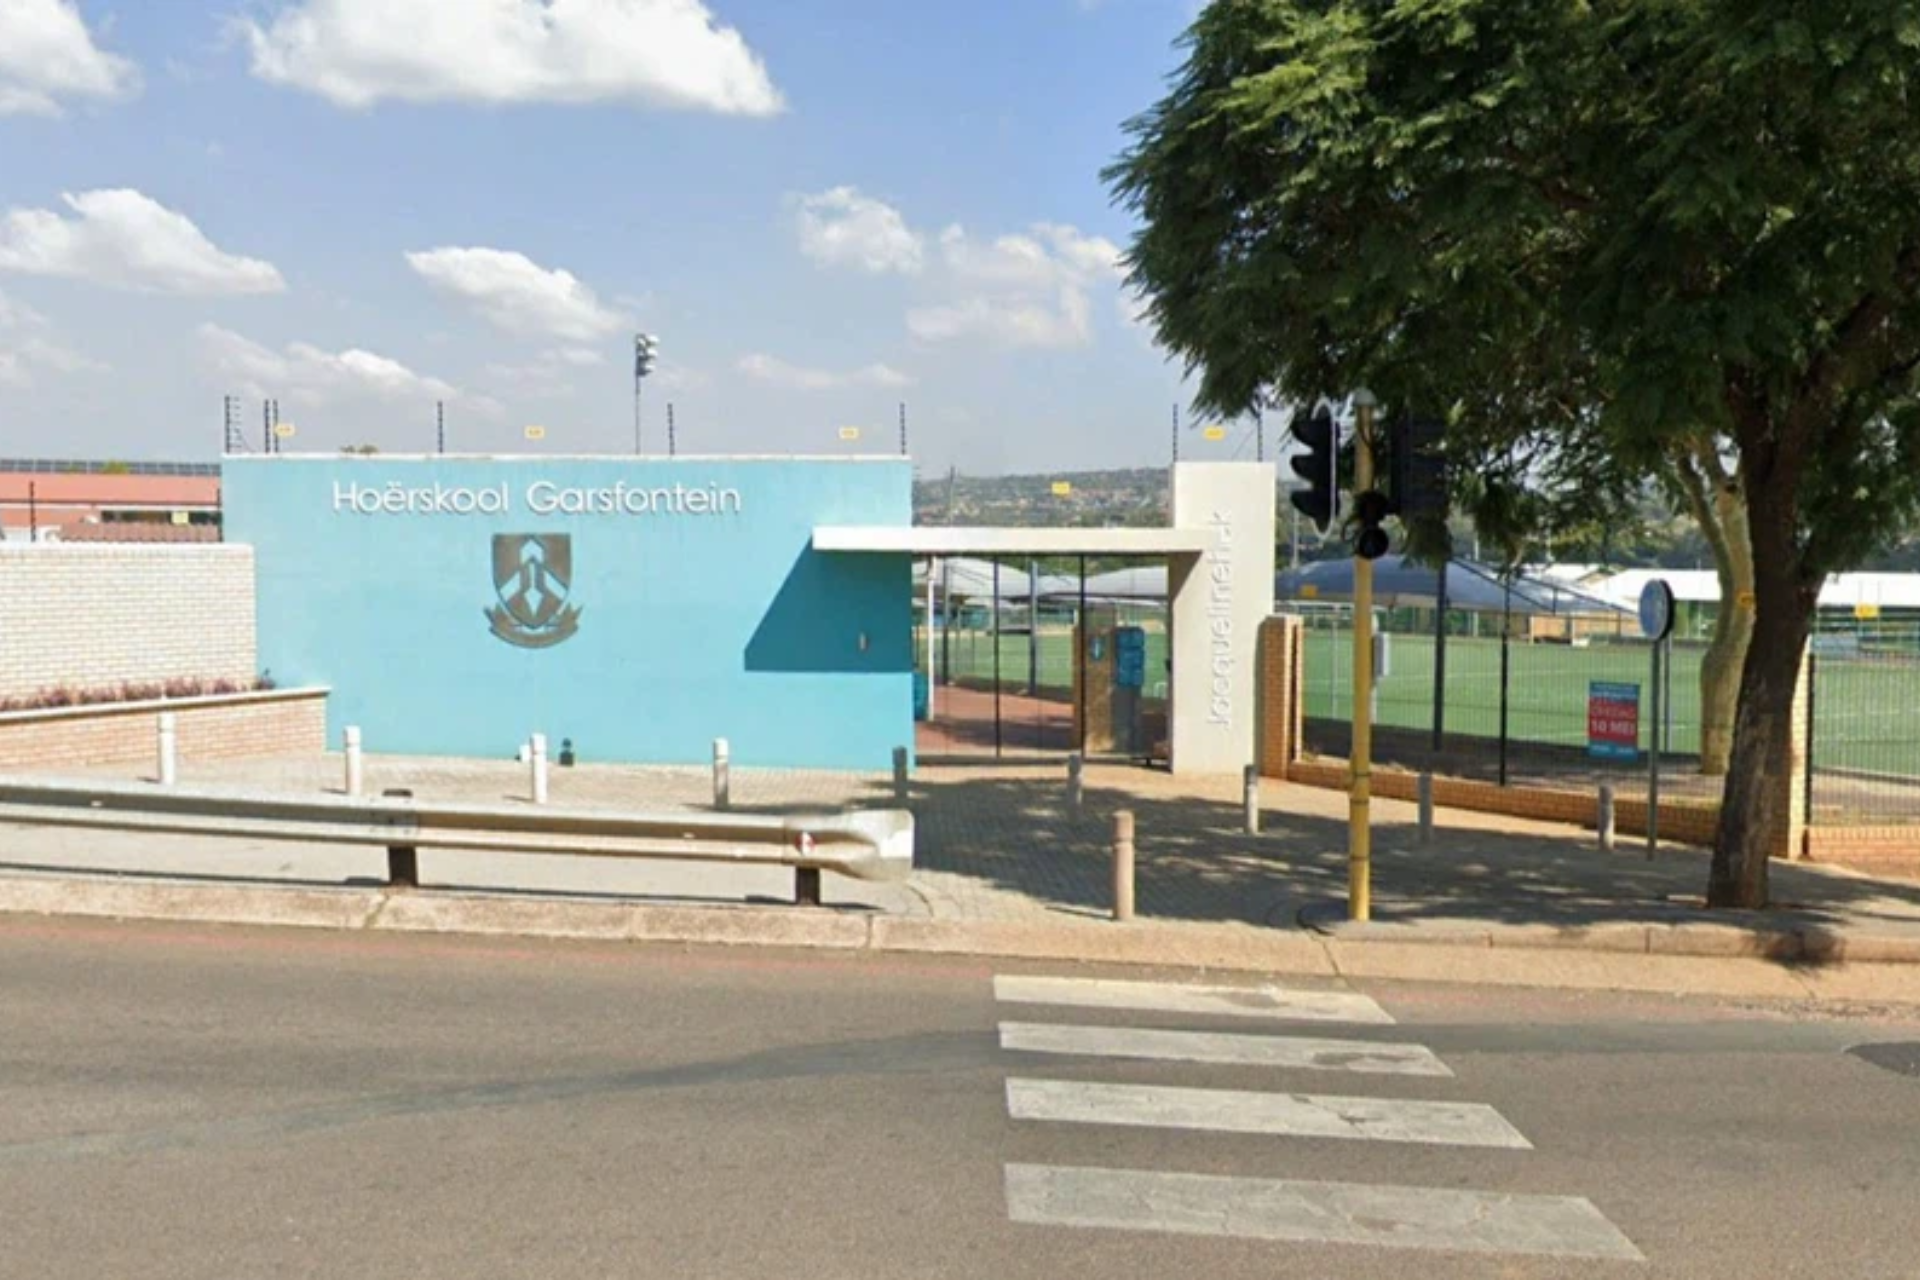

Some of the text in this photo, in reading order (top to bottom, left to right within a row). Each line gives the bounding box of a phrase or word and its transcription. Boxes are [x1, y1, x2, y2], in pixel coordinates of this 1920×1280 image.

[332, 479, 741, 513] Hoërskool Garsfontein
[1591, 719, 1636, 736] 10 MEI
